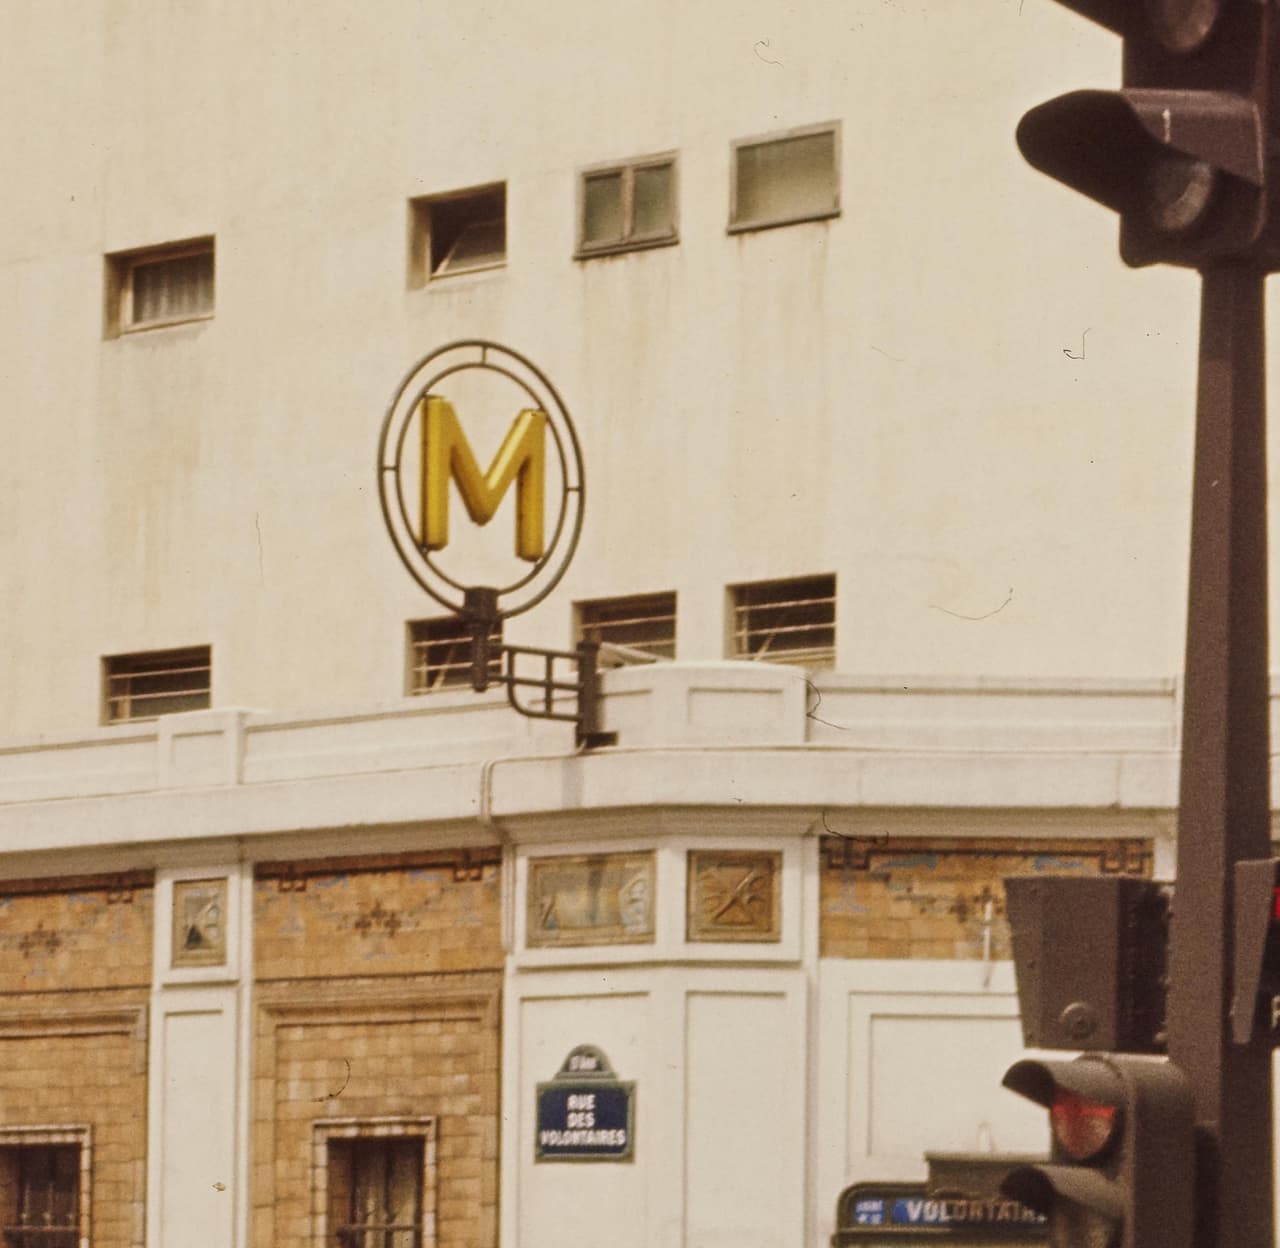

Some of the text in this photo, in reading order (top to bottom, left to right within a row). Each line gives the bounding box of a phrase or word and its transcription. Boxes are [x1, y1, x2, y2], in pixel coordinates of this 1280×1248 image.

[419, 394, 547, 563] M
[567, 1094, 596, 1110] RUE
[567, 1112, 596, 1128] DES
[540, 1129, 626, 1146] VOLONTAIRES
